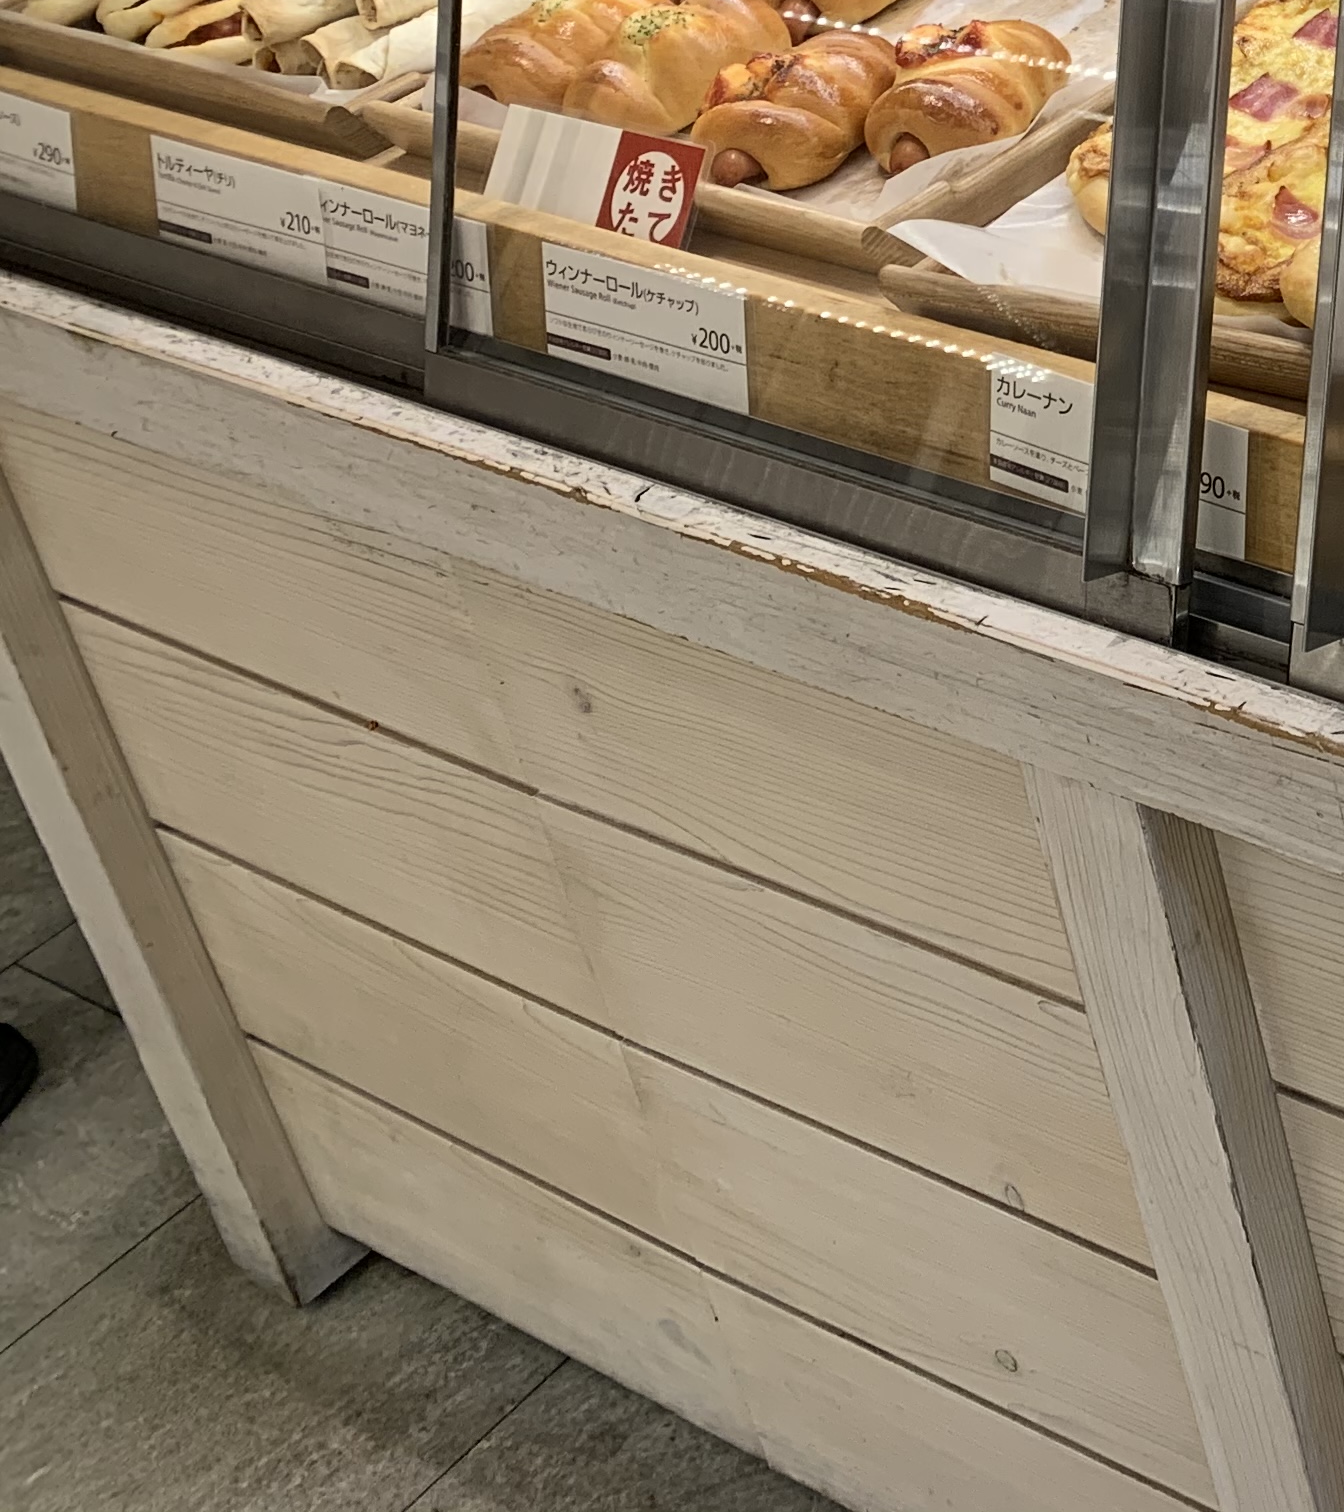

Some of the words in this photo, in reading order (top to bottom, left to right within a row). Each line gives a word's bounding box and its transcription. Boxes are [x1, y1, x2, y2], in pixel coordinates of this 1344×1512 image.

[622, 158, 683, 204] 焼き
[545, 260, 700, 317] ウィンナーロール(ケチャップ)
[996, 376, 1074, 415] カレーナン
[996, 397, 1016, 414] Curry
[1016, 405, 1037, 419] Naan
